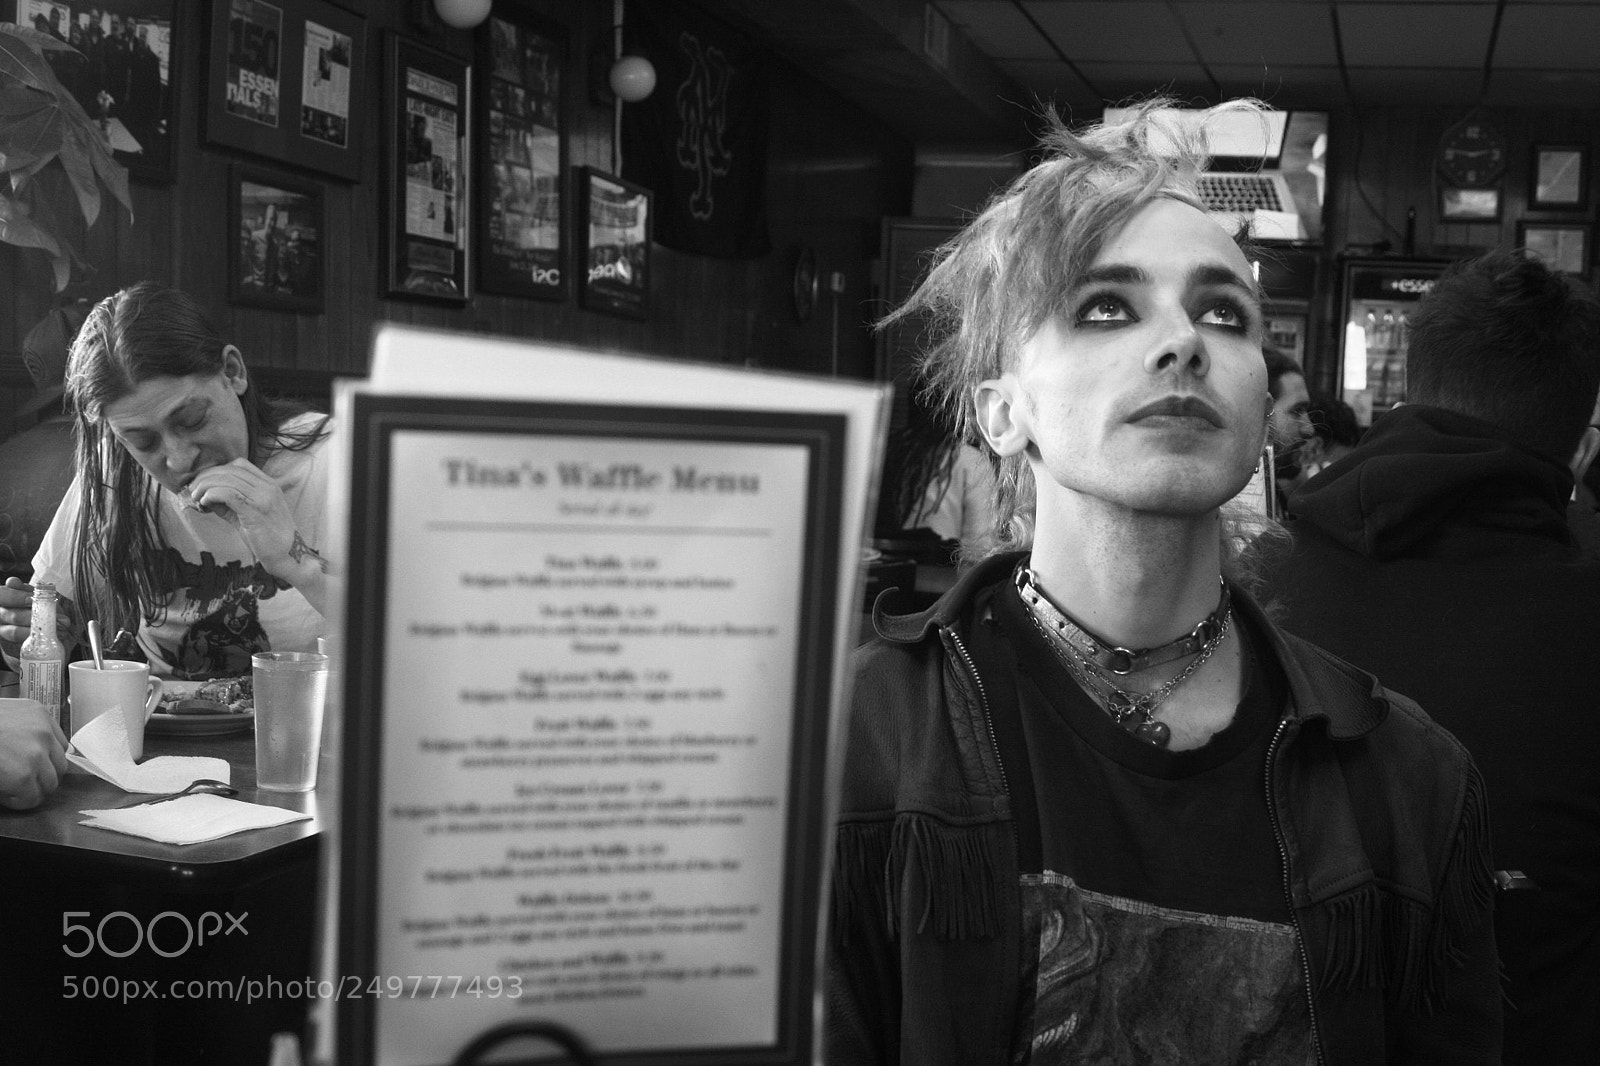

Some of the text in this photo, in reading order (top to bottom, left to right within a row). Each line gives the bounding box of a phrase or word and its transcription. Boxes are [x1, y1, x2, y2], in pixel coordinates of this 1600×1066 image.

[443, 458, 761, 496] Tina's Waffle Menu
